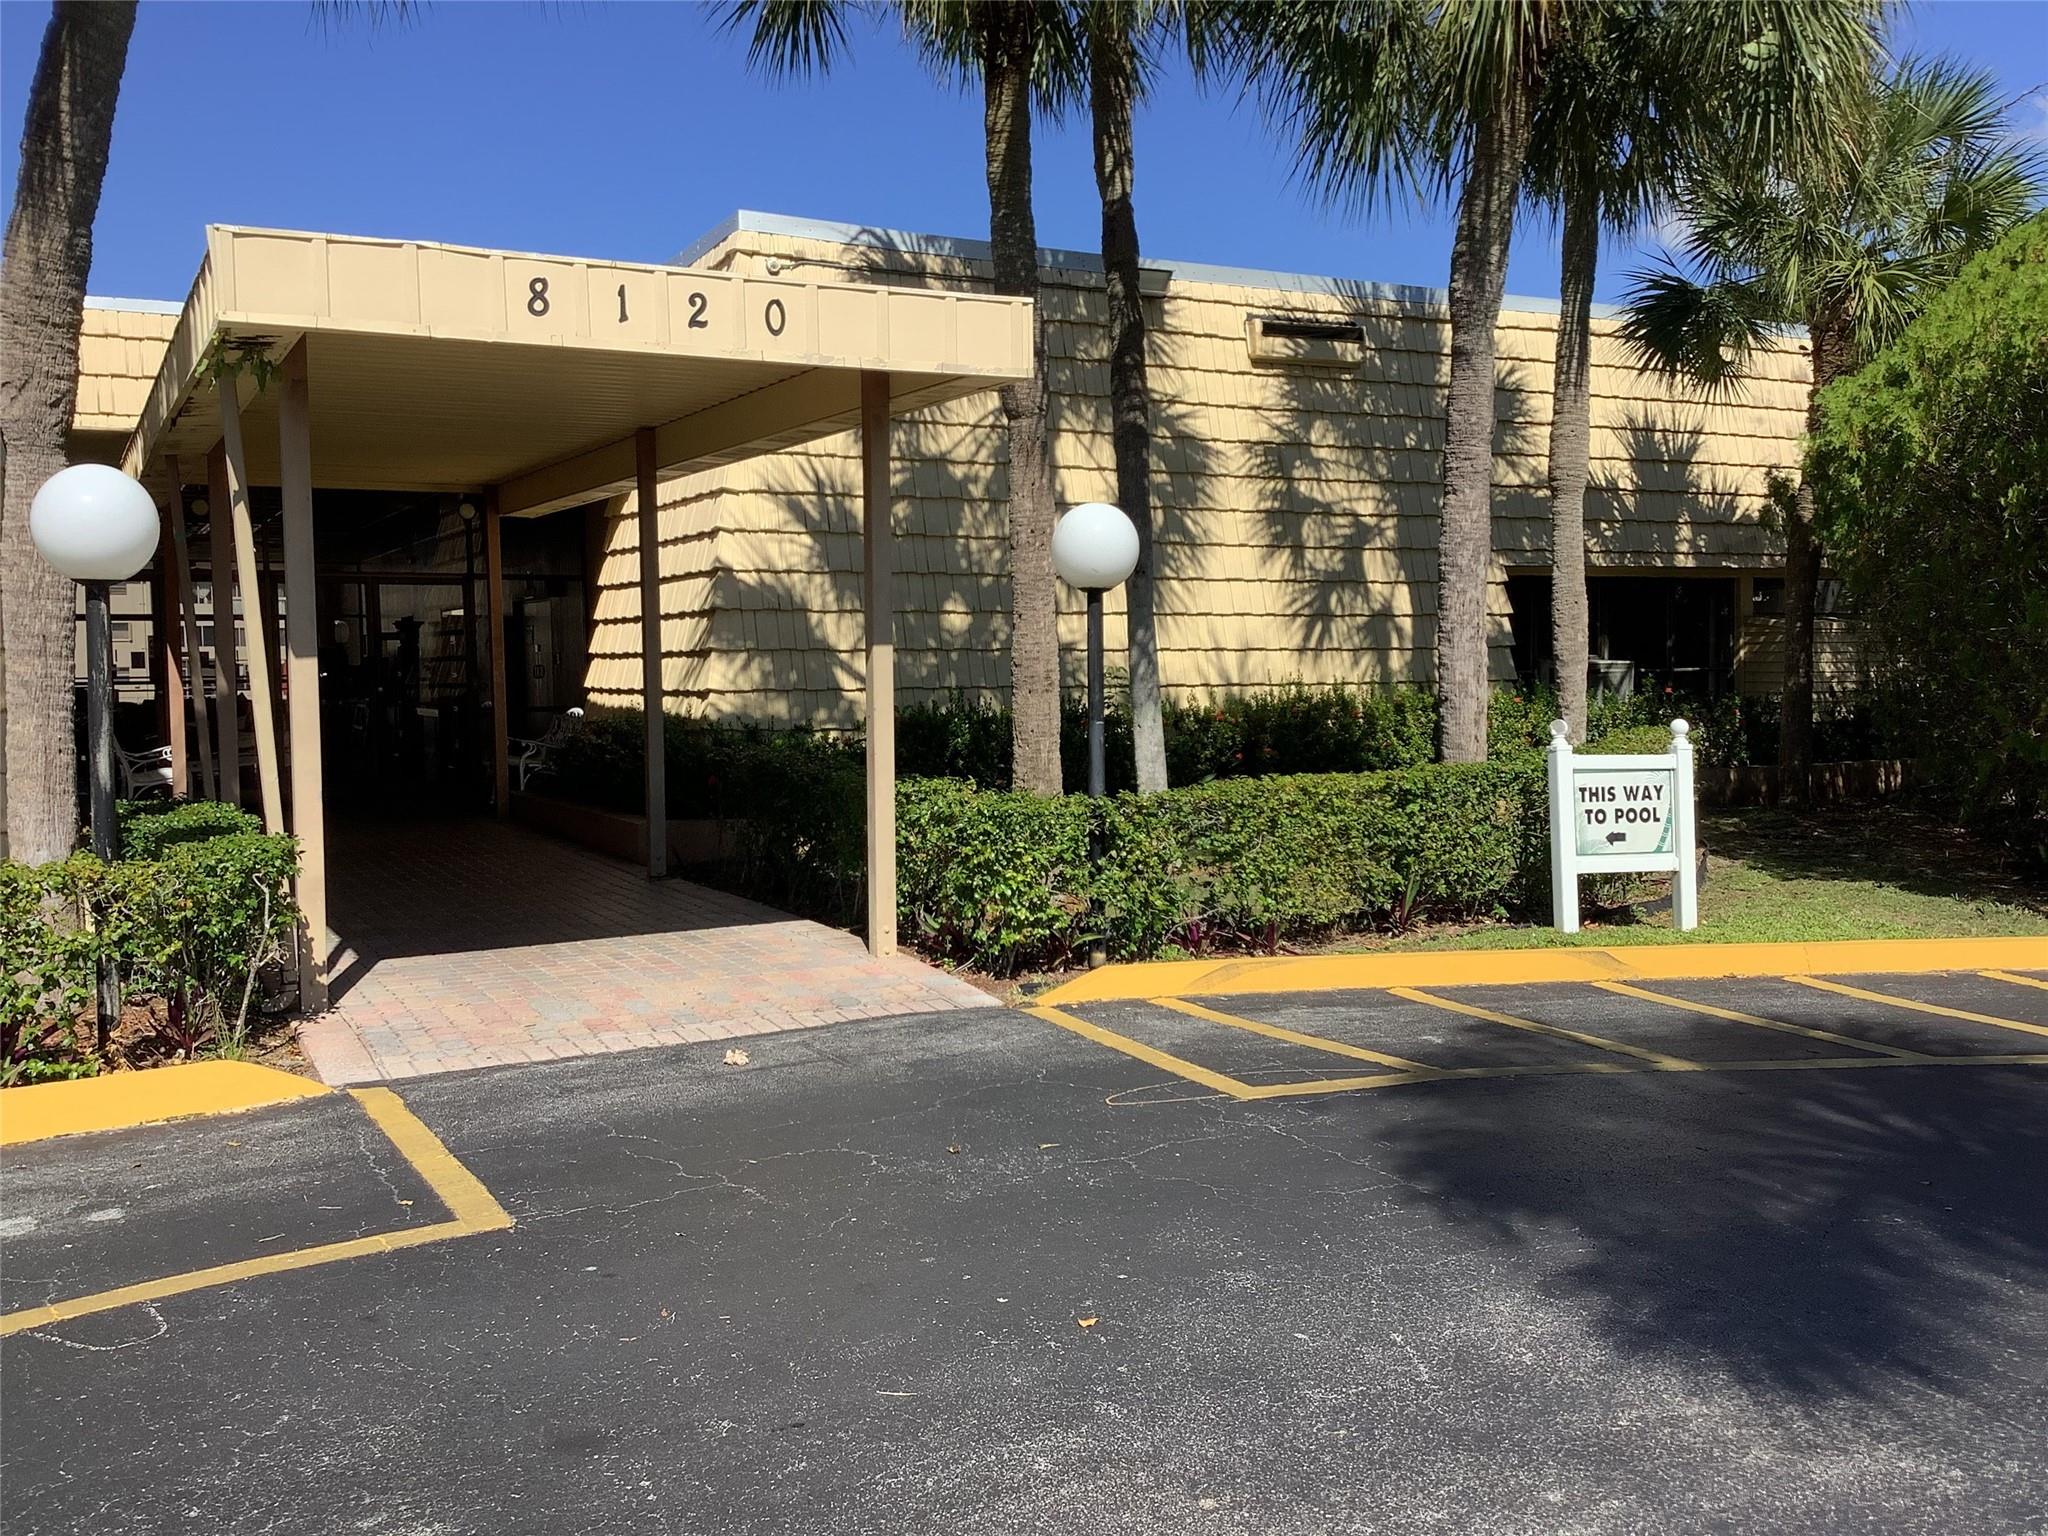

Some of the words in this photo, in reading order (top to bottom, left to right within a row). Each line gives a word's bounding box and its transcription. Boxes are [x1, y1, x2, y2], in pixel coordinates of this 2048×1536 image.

[527, 277, 786, 337] 8120
[1579, 786, 1616, 803] THIS
[1623, 785, 1664, 801] WAY
[1585, 808, 1607, 825] TO
[1615, 807, 1661, 824] POOL
